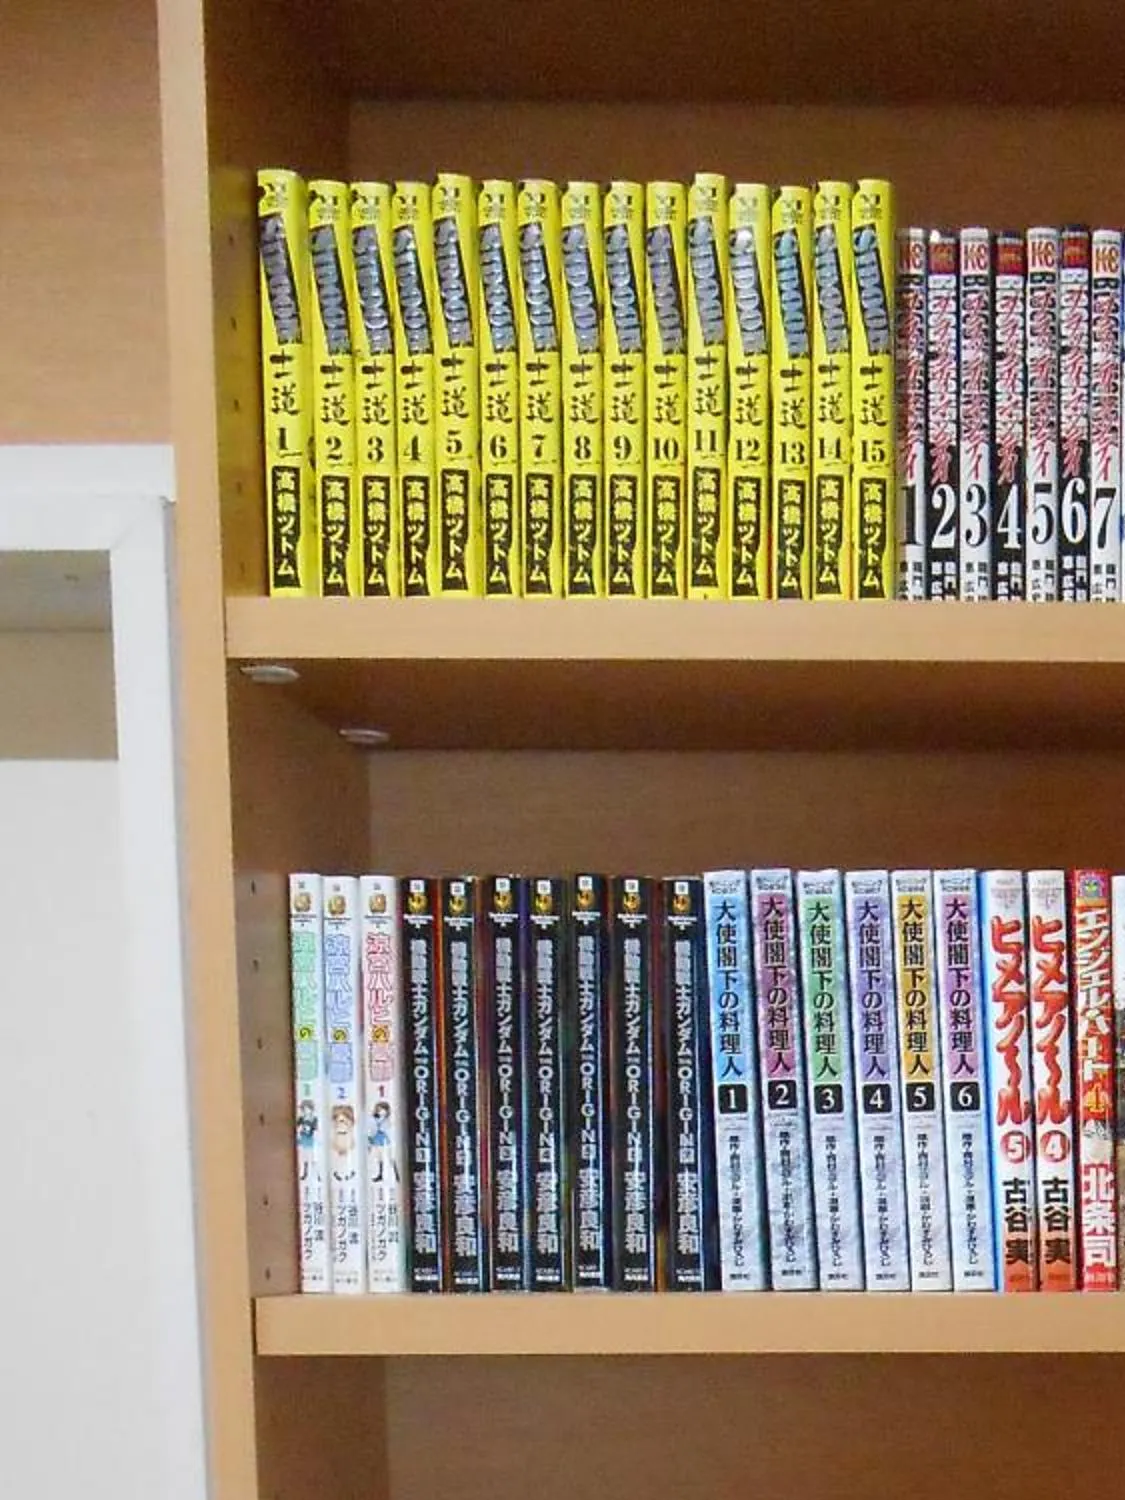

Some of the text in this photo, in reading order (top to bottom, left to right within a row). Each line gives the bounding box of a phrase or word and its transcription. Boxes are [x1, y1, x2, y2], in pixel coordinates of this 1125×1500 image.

[277, 427, 289, 451] 1
[326, 437, 342, 461] 2
[368, 437, 384, 461] 3
[404, 437, 420, 461] 4
[446, 430, 462, 454] 5
[490, 435, 507, 459] 6
[531, 434, 548, 459] 7
[574, 436, 591, 460] 8
[614, 436, 633, 460] 9
[652, 437, 679, 461] 10
[694, 429, 718, 453] 11
[735, 438, 761, 462] 12
[818, 437, 842, 460] 14
[860, 439, 886, 463] 15
[780, 440, 805, 465] 13
[931, 484, 956, 548] 2
[965, 484, 988, 546] 3
[998, 484, 1022, 549] 4
[1031, 483, 1054, 544] 5
[1061, 478, 1087, 544] 6
[1094, 488, 1116, 549] 7
[715, 901, 742, 1077] 大使閣下の料理人
[762, 897, 791, 1072] 大使閣下の料理人
[809, 901, 839, 1077] 大使閣下の料理人
[858, 900, 890, 1077] 大使閣下の料理人
[901, 899, 929, 1076] 大使閣下の料理人
[945, 899, 973, 1075] 大使閣下の料理人
[726, 1090, 737, 1110] 1
[775, 1084, 789, 1105] 2
[821, 1090, 835, 1110] 3
[869, 1090, 884, 1109] 4
[913, 1088, 927, 1108] 5
[957, 1088, 972, 1108] 6
